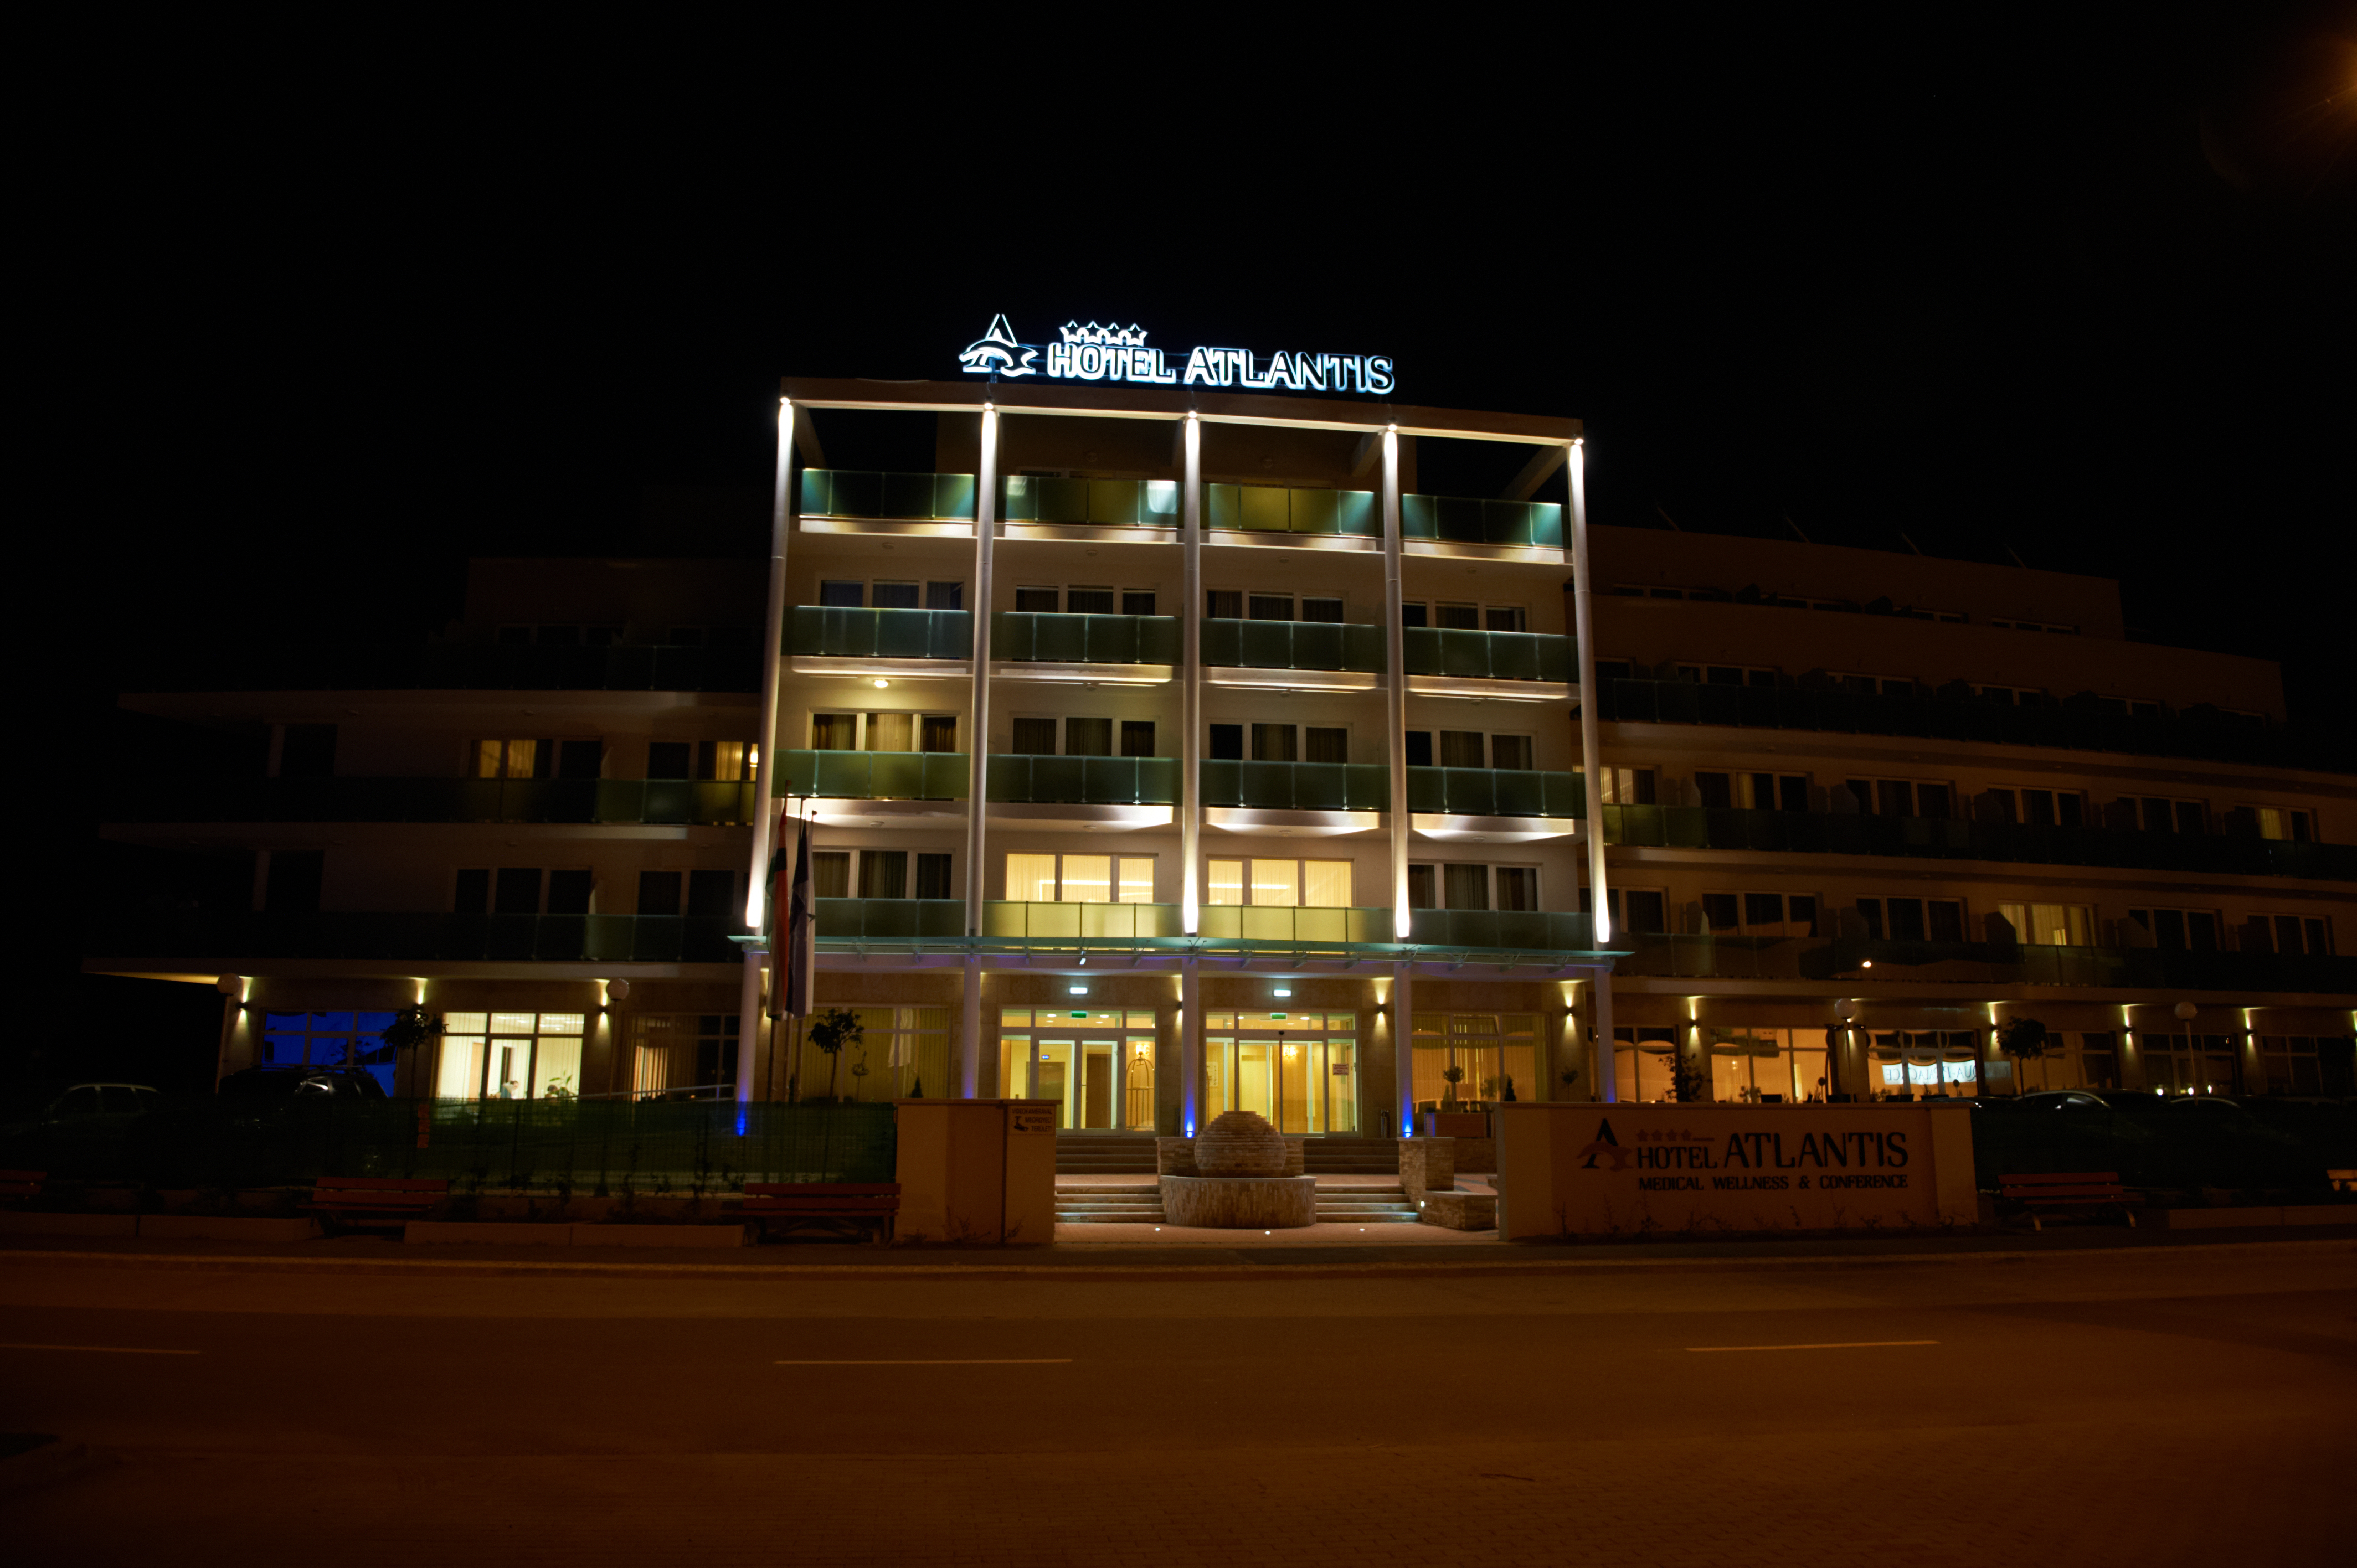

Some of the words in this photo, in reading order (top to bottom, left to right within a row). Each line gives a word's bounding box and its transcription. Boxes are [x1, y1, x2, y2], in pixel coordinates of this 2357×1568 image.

[1047, 342, 1176, 384] HOTEL
[1183, 346, 1396, 395] ATLANTIS
[1636, 1146, 1717, 1169] HOTEL
[1723, 1132, 1909, 1168] ATLANTIS
[1639, 1176, 1704, 1191] MEDICAL
[1712, 1176, 1789, 1190] WELLNESS
[1799, 1175, 1810, 1189] &
[1819, 1174, 1908, 1190] CONFERENCE
